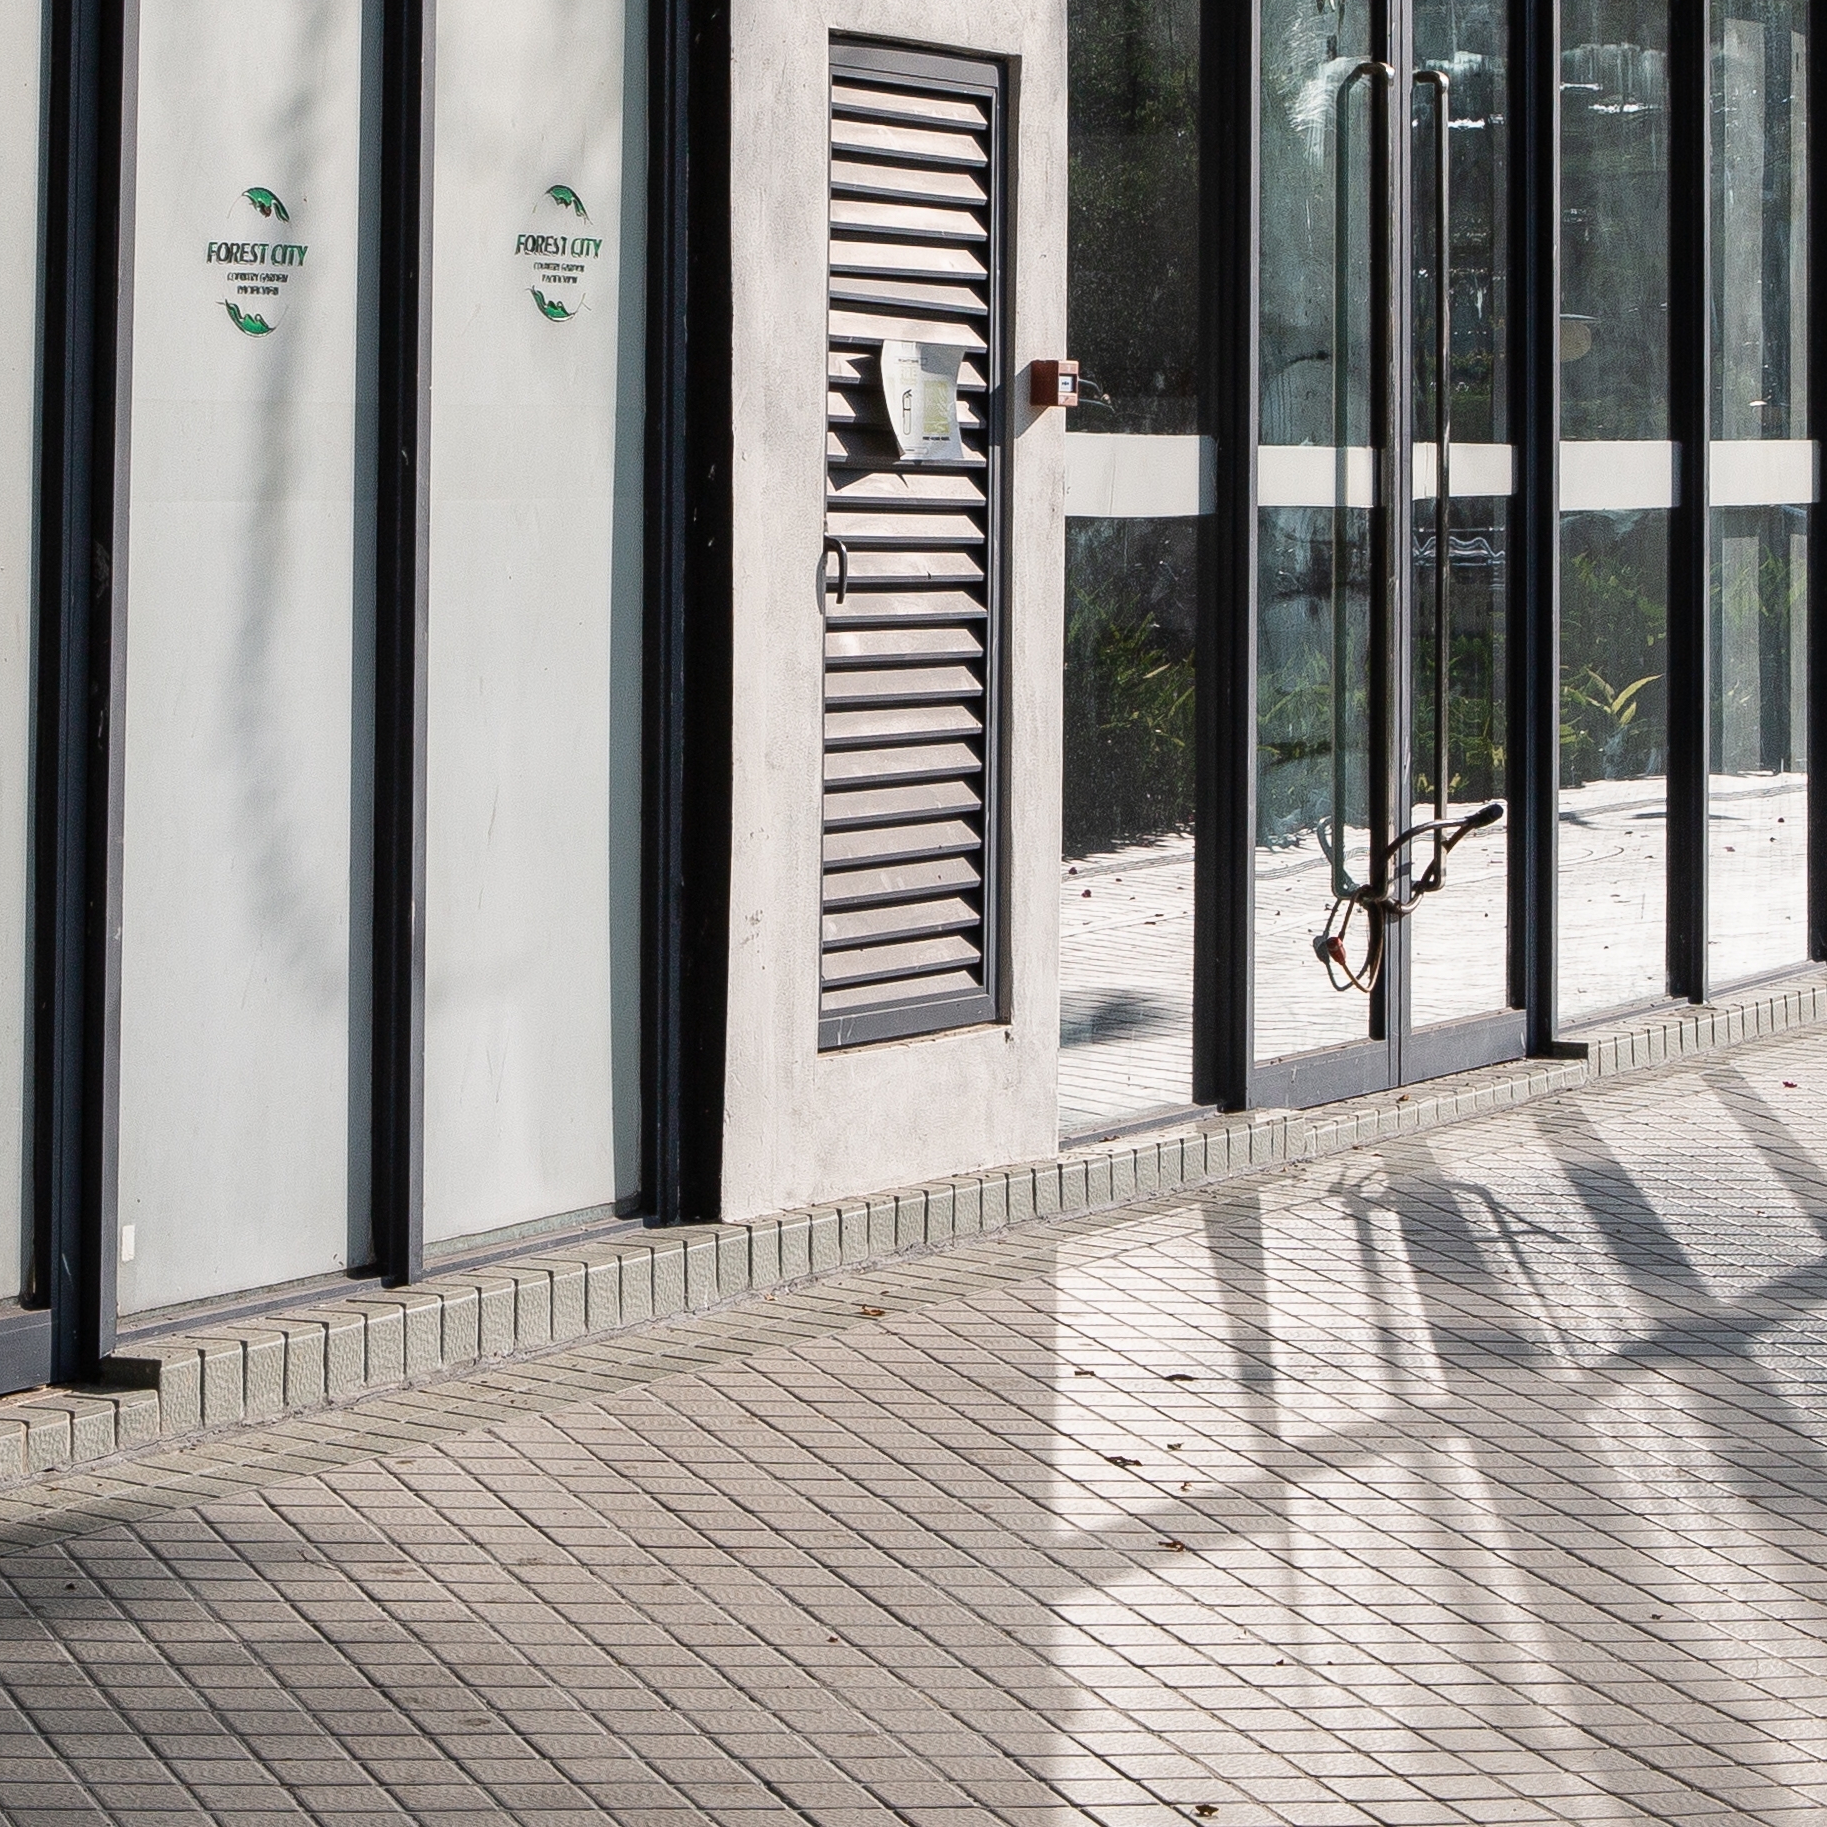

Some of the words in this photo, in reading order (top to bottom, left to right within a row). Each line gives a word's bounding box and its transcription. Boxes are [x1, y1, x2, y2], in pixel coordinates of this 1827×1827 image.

[207, 242, 269, 265] FOREST
[271, 243, 308, 266] CITY
[514, 234, 567, 257] FOREST
[571, 237, 603, 259] CITY
